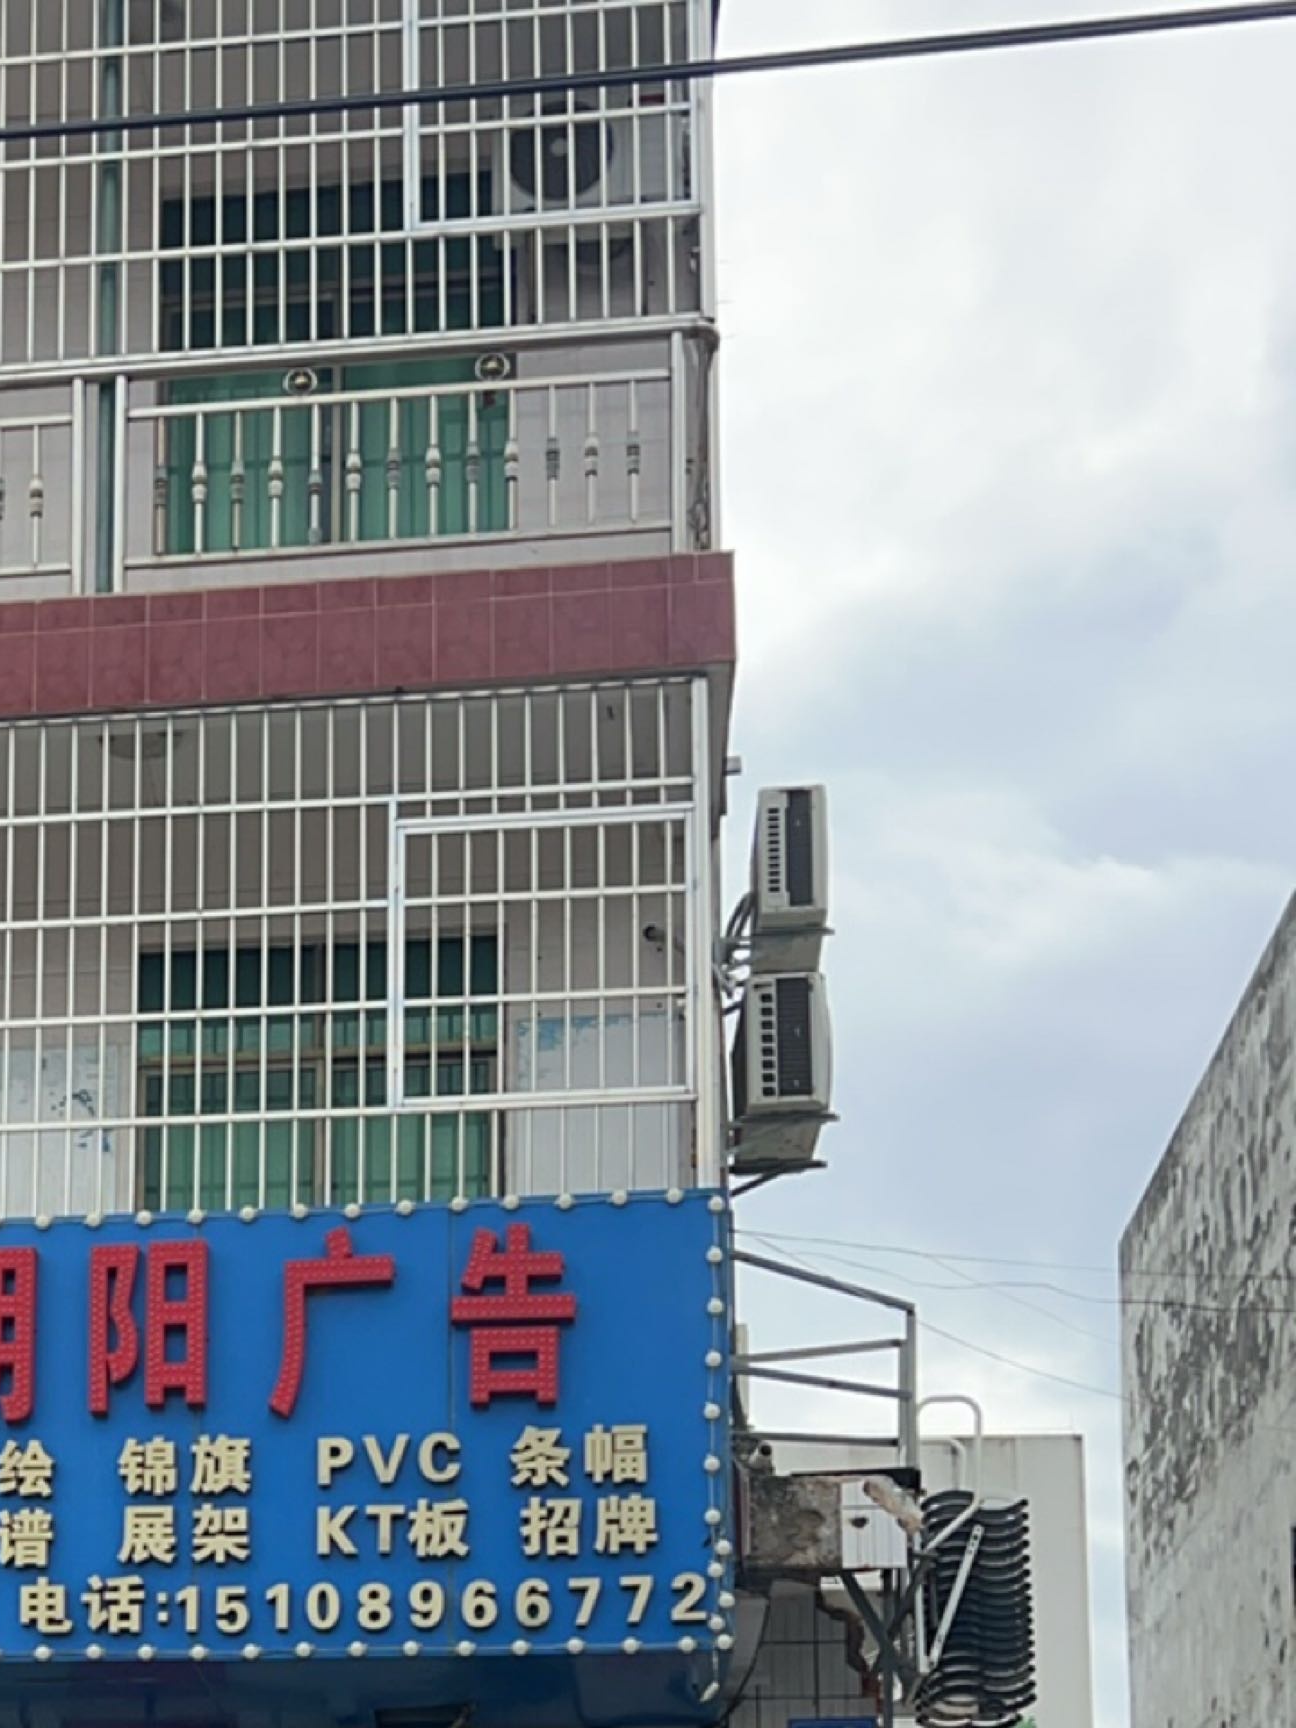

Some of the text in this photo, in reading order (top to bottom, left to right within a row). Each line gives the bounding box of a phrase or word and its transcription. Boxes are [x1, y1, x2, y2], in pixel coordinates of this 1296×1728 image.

[118, 1436, 253, 1496] 锦旗
[316, 1431, 462, 1487] PVC
[510, 1424, 648, 1488] 条幅
[118, 1502, 251, 1565] 展架
[316, 1498, 469, 1558] KT板
[521, 1493, 659, 1558] 招牌
